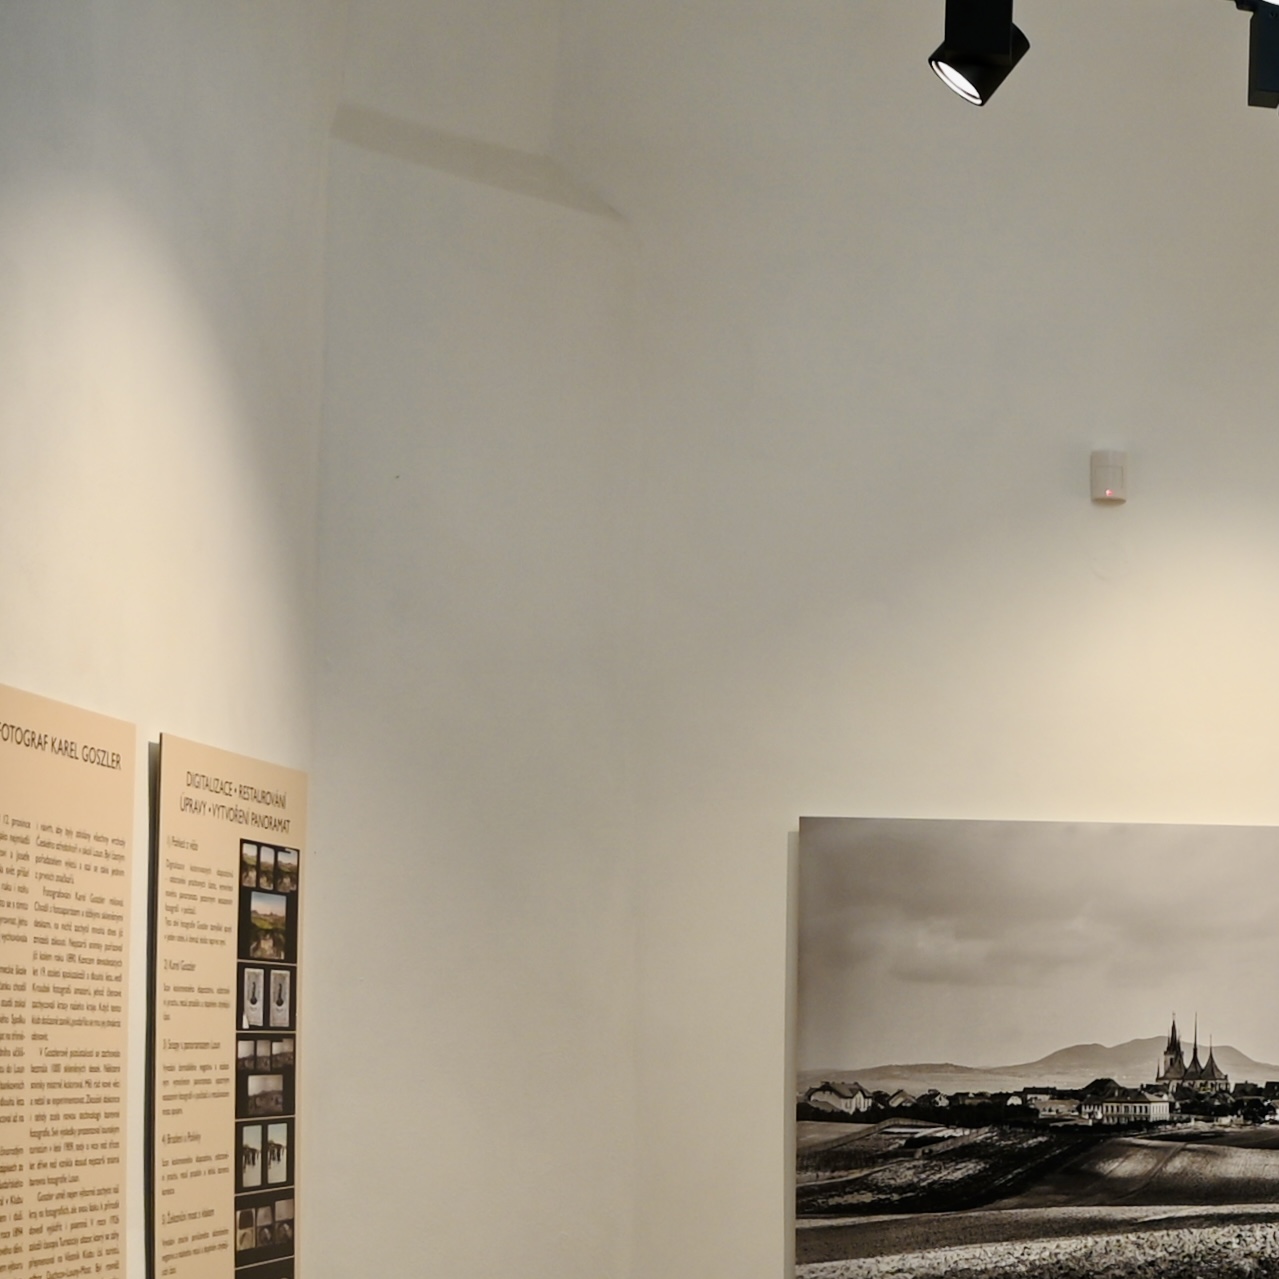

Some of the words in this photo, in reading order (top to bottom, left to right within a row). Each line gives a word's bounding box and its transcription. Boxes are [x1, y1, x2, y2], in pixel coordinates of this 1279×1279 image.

[0, 722, 48, 751] OTOGRAF
[51, 736, 79, 760] KAREL
[82, 745, 122, 769] GOSZLER
[186, 771, 233, 796] DIGITALIZACE
[251, 812, 291, 833] PANORAMAT
